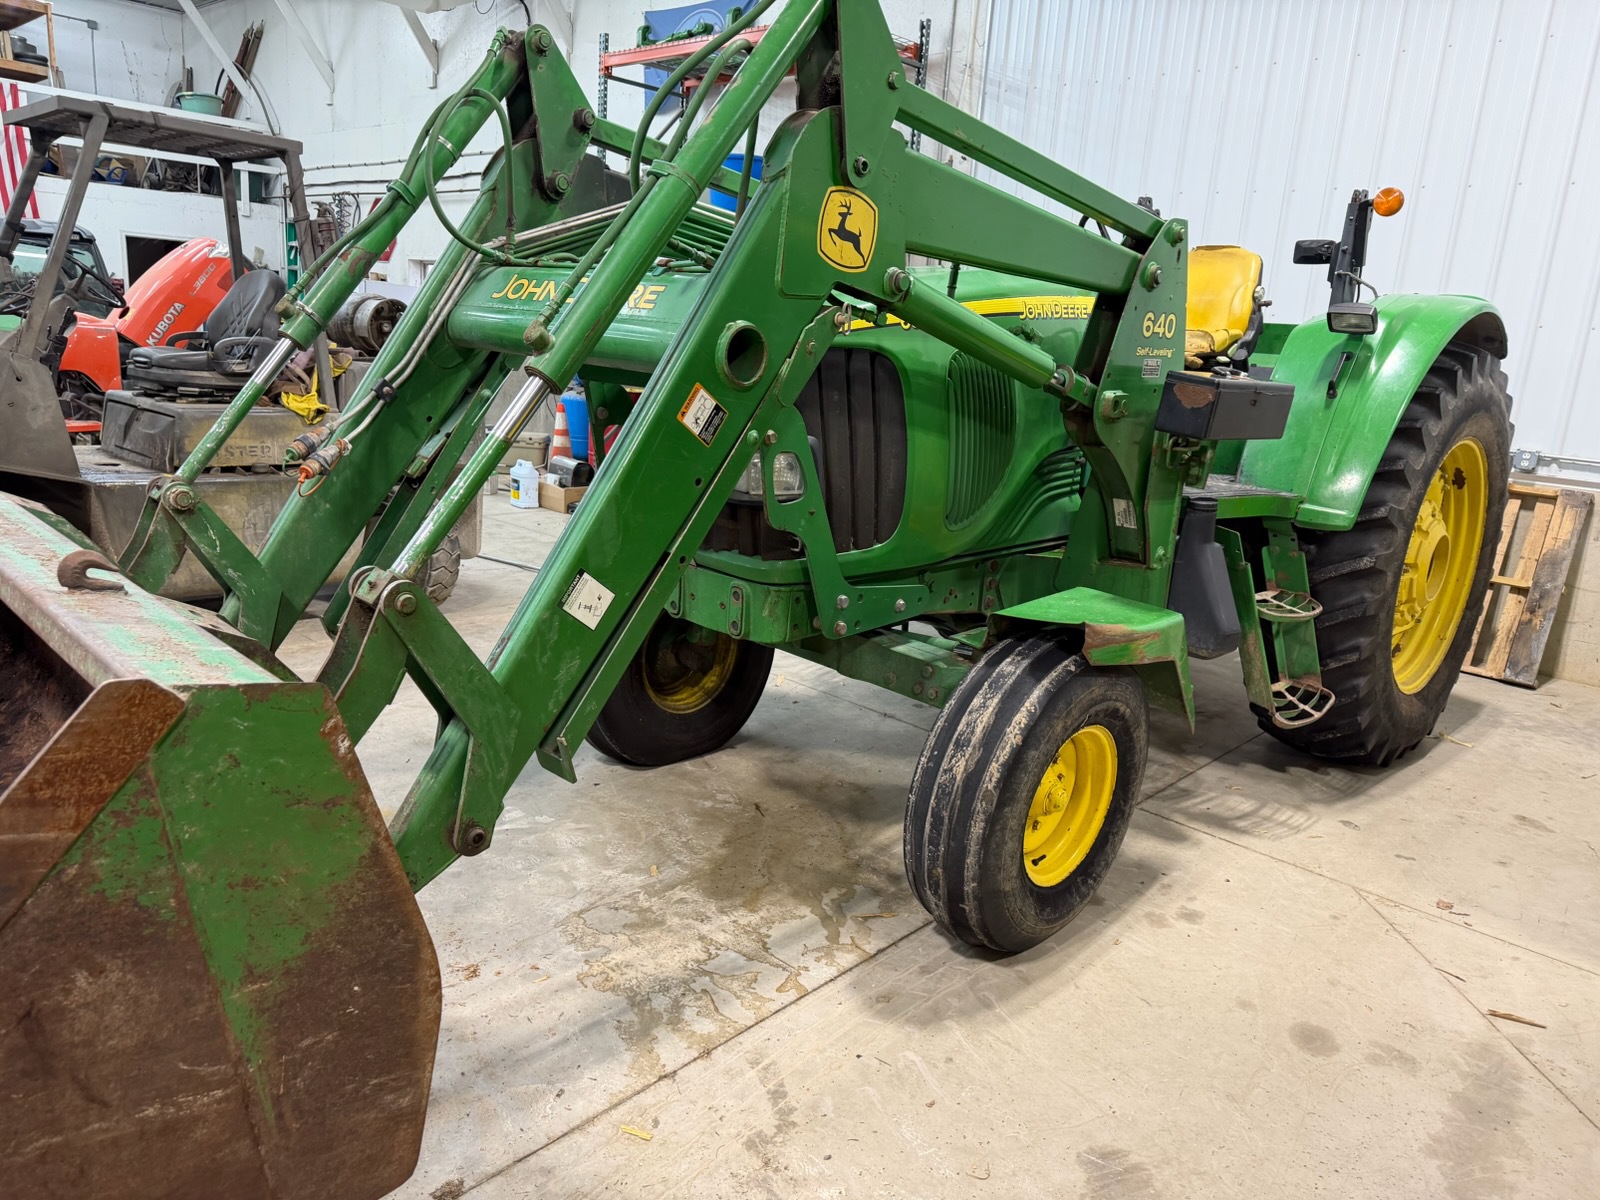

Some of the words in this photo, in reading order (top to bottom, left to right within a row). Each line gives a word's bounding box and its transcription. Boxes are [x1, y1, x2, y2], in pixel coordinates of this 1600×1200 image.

[145, 302, 186, 346] KUBOTA
[1019, 301, 1051, 320] JOHN
[1052, 300, 1088, 319] DEERE
[1143, 311, 1176, 339] 640
[215, 445, 273, 458] STER
[561, 574, 581, 602] IMPORTANT
